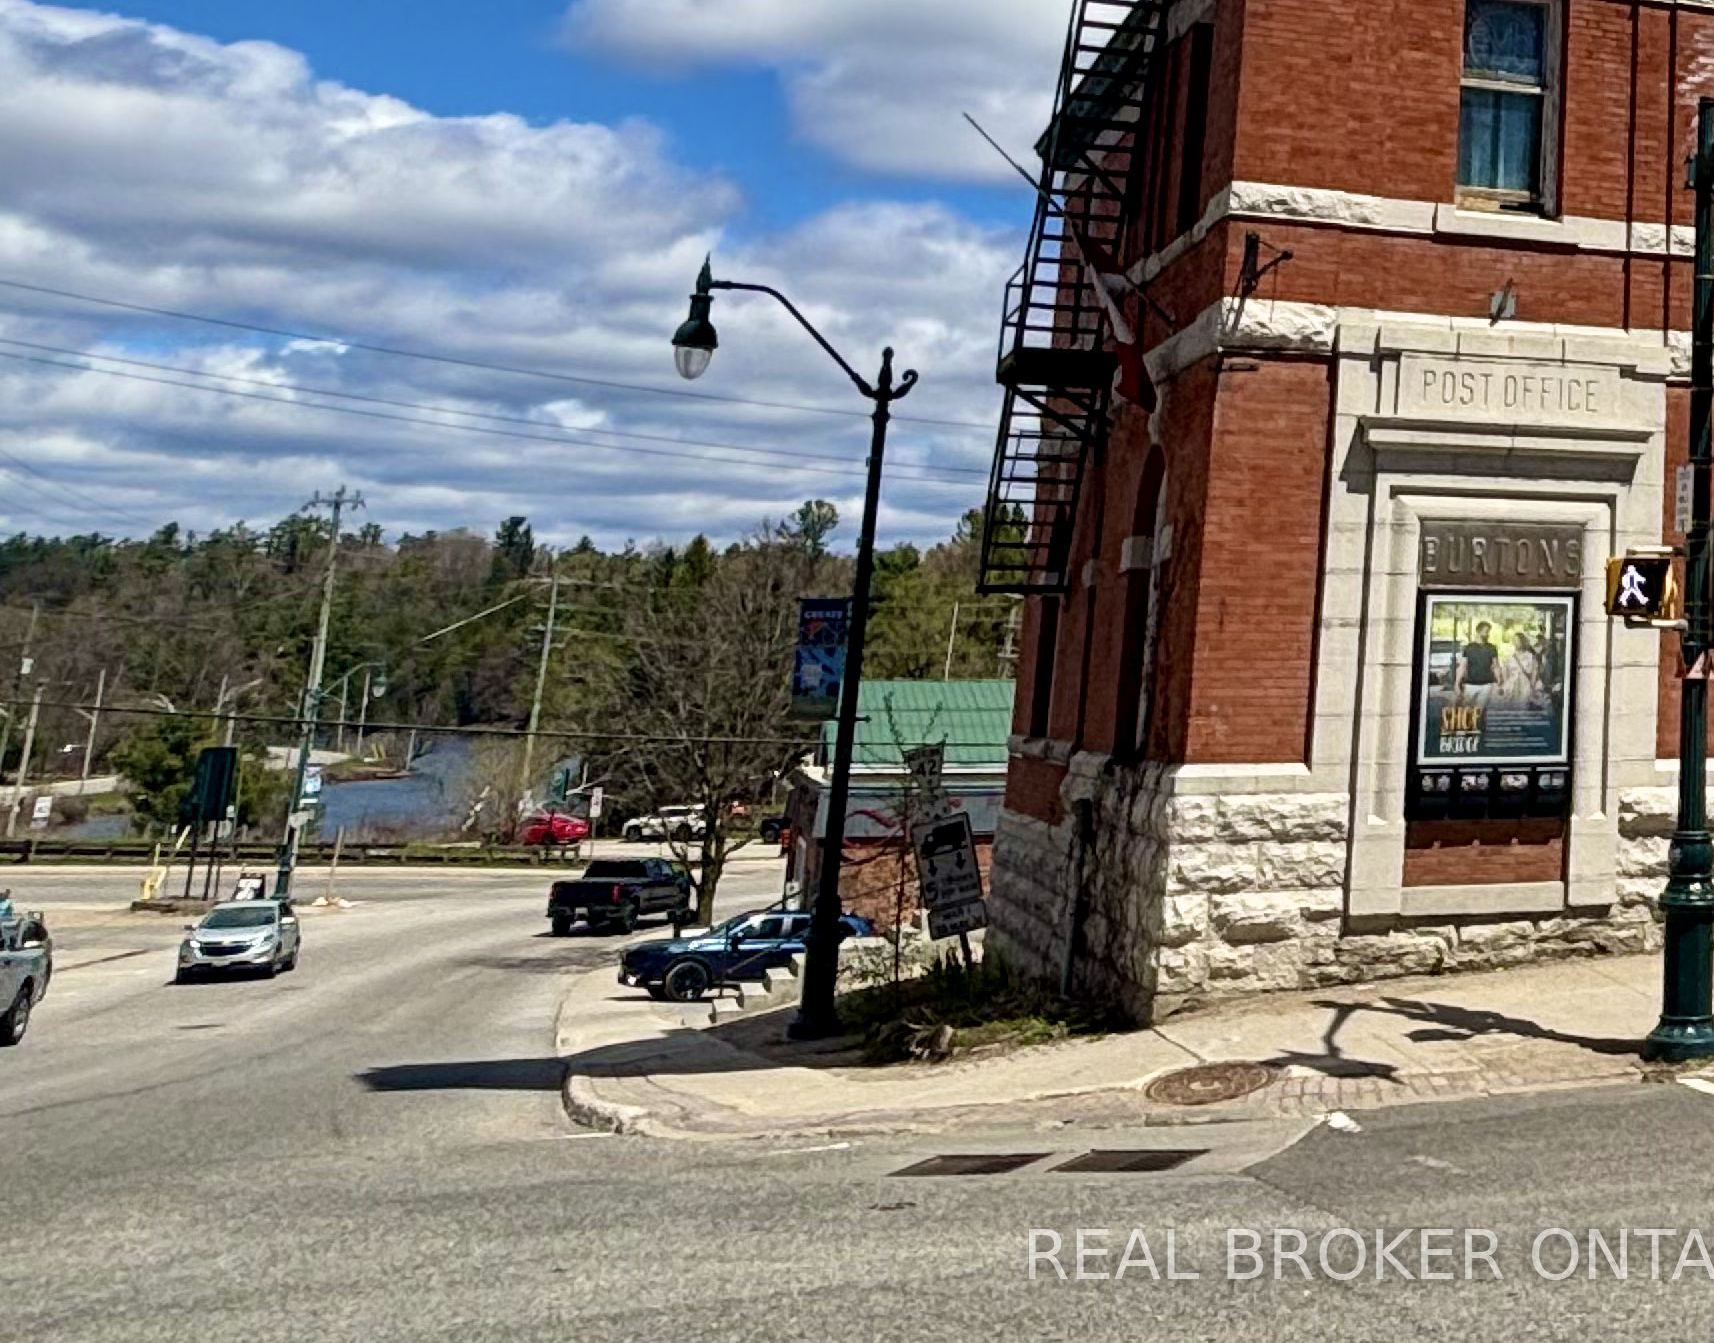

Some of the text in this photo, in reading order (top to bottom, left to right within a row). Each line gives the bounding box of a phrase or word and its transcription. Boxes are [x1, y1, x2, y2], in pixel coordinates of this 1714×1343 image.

[1422, 369, 1600, 413] POST OFFICE
[1423, 536, 1582, 578] BURTONS
